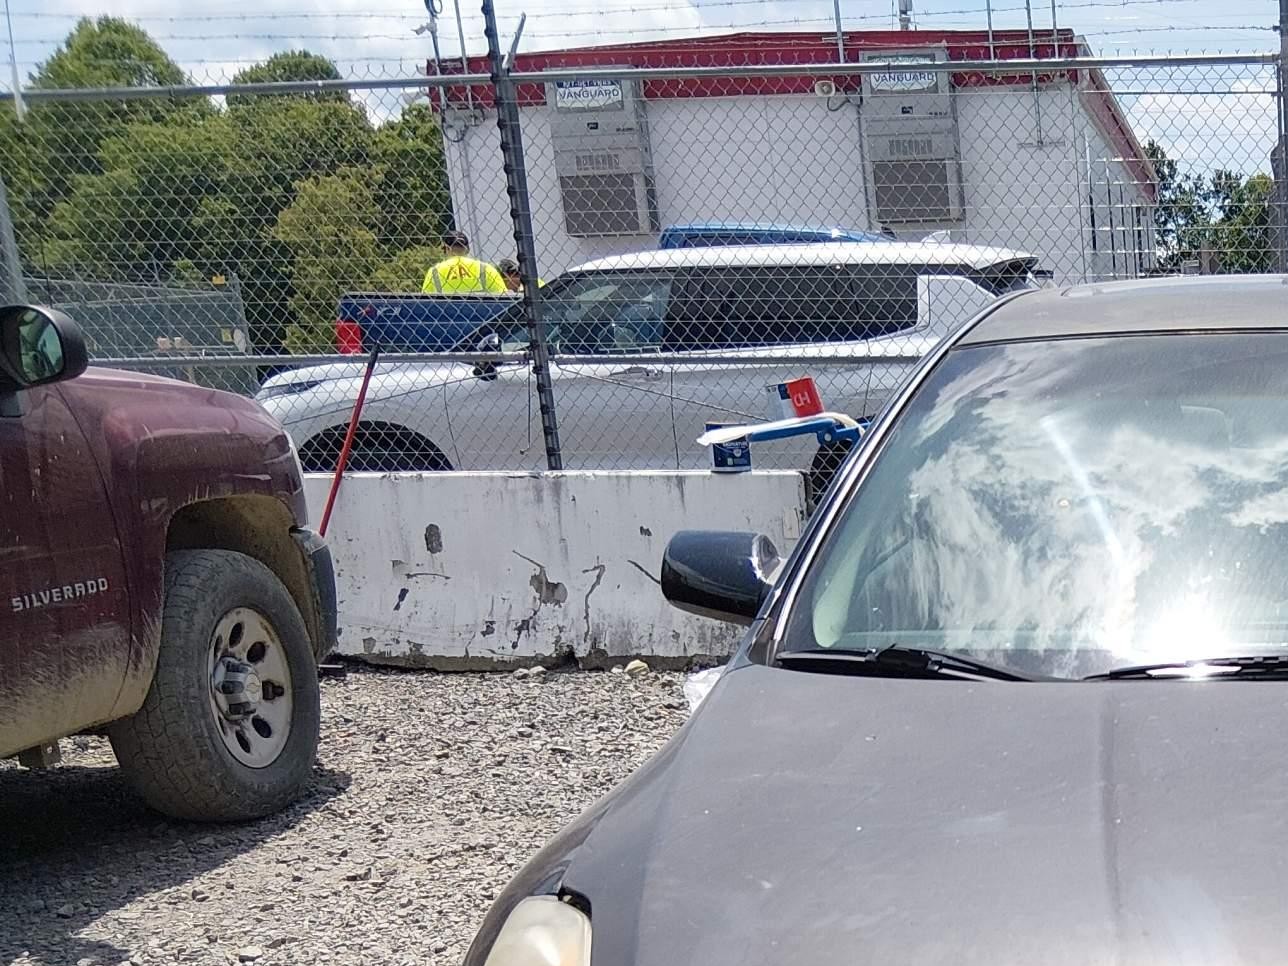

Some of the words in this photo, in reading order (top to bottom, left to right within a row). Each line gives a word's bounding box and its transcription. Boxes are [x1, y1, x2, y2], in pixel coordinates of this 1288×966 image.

[872, 71, 934, 82] VANGUARD
[558, 88, 620, 100] VANGUARD
[11, 577, 109, 612] SILVERADO
